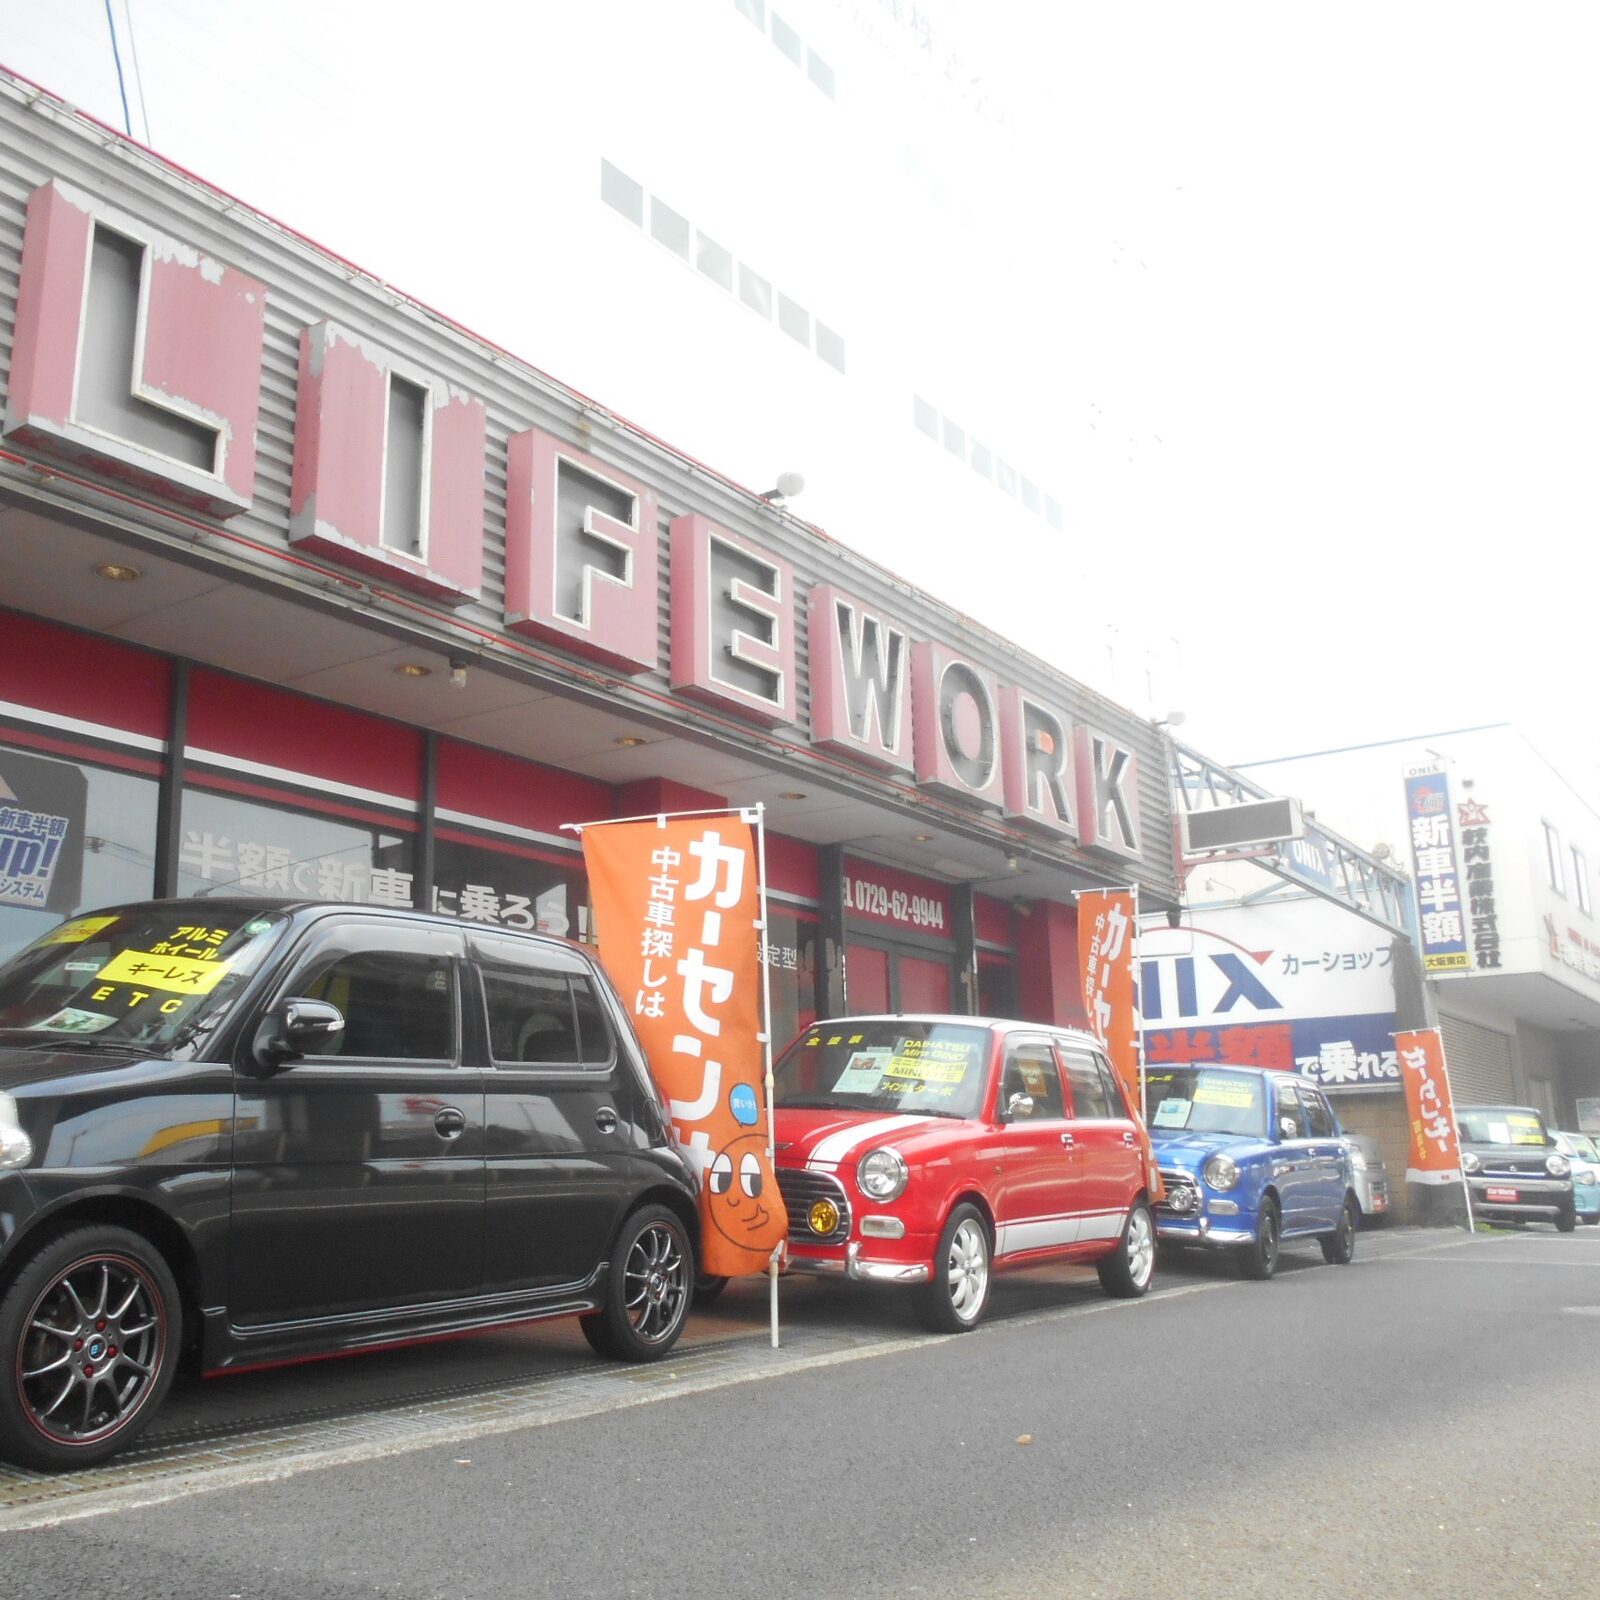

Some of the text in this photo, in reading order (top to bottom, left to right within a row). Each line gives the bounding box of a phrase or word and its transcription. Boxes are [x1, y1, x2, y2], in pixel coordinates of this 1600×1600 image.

[70, 216, 1140, 853] LIFE WORK
[0, 809, 66, 836] 新車半額
[1412, 814, 1462, 944] 新車半額
[855, 880, 944, 929] 0729-62-9944
[170, 926, 228, 946] アルミ
[636, 846, 681, 1018] 中古車探しは
[150, 942, 219, 961] ホイール
[129, 963, 205, 985] キーレス
